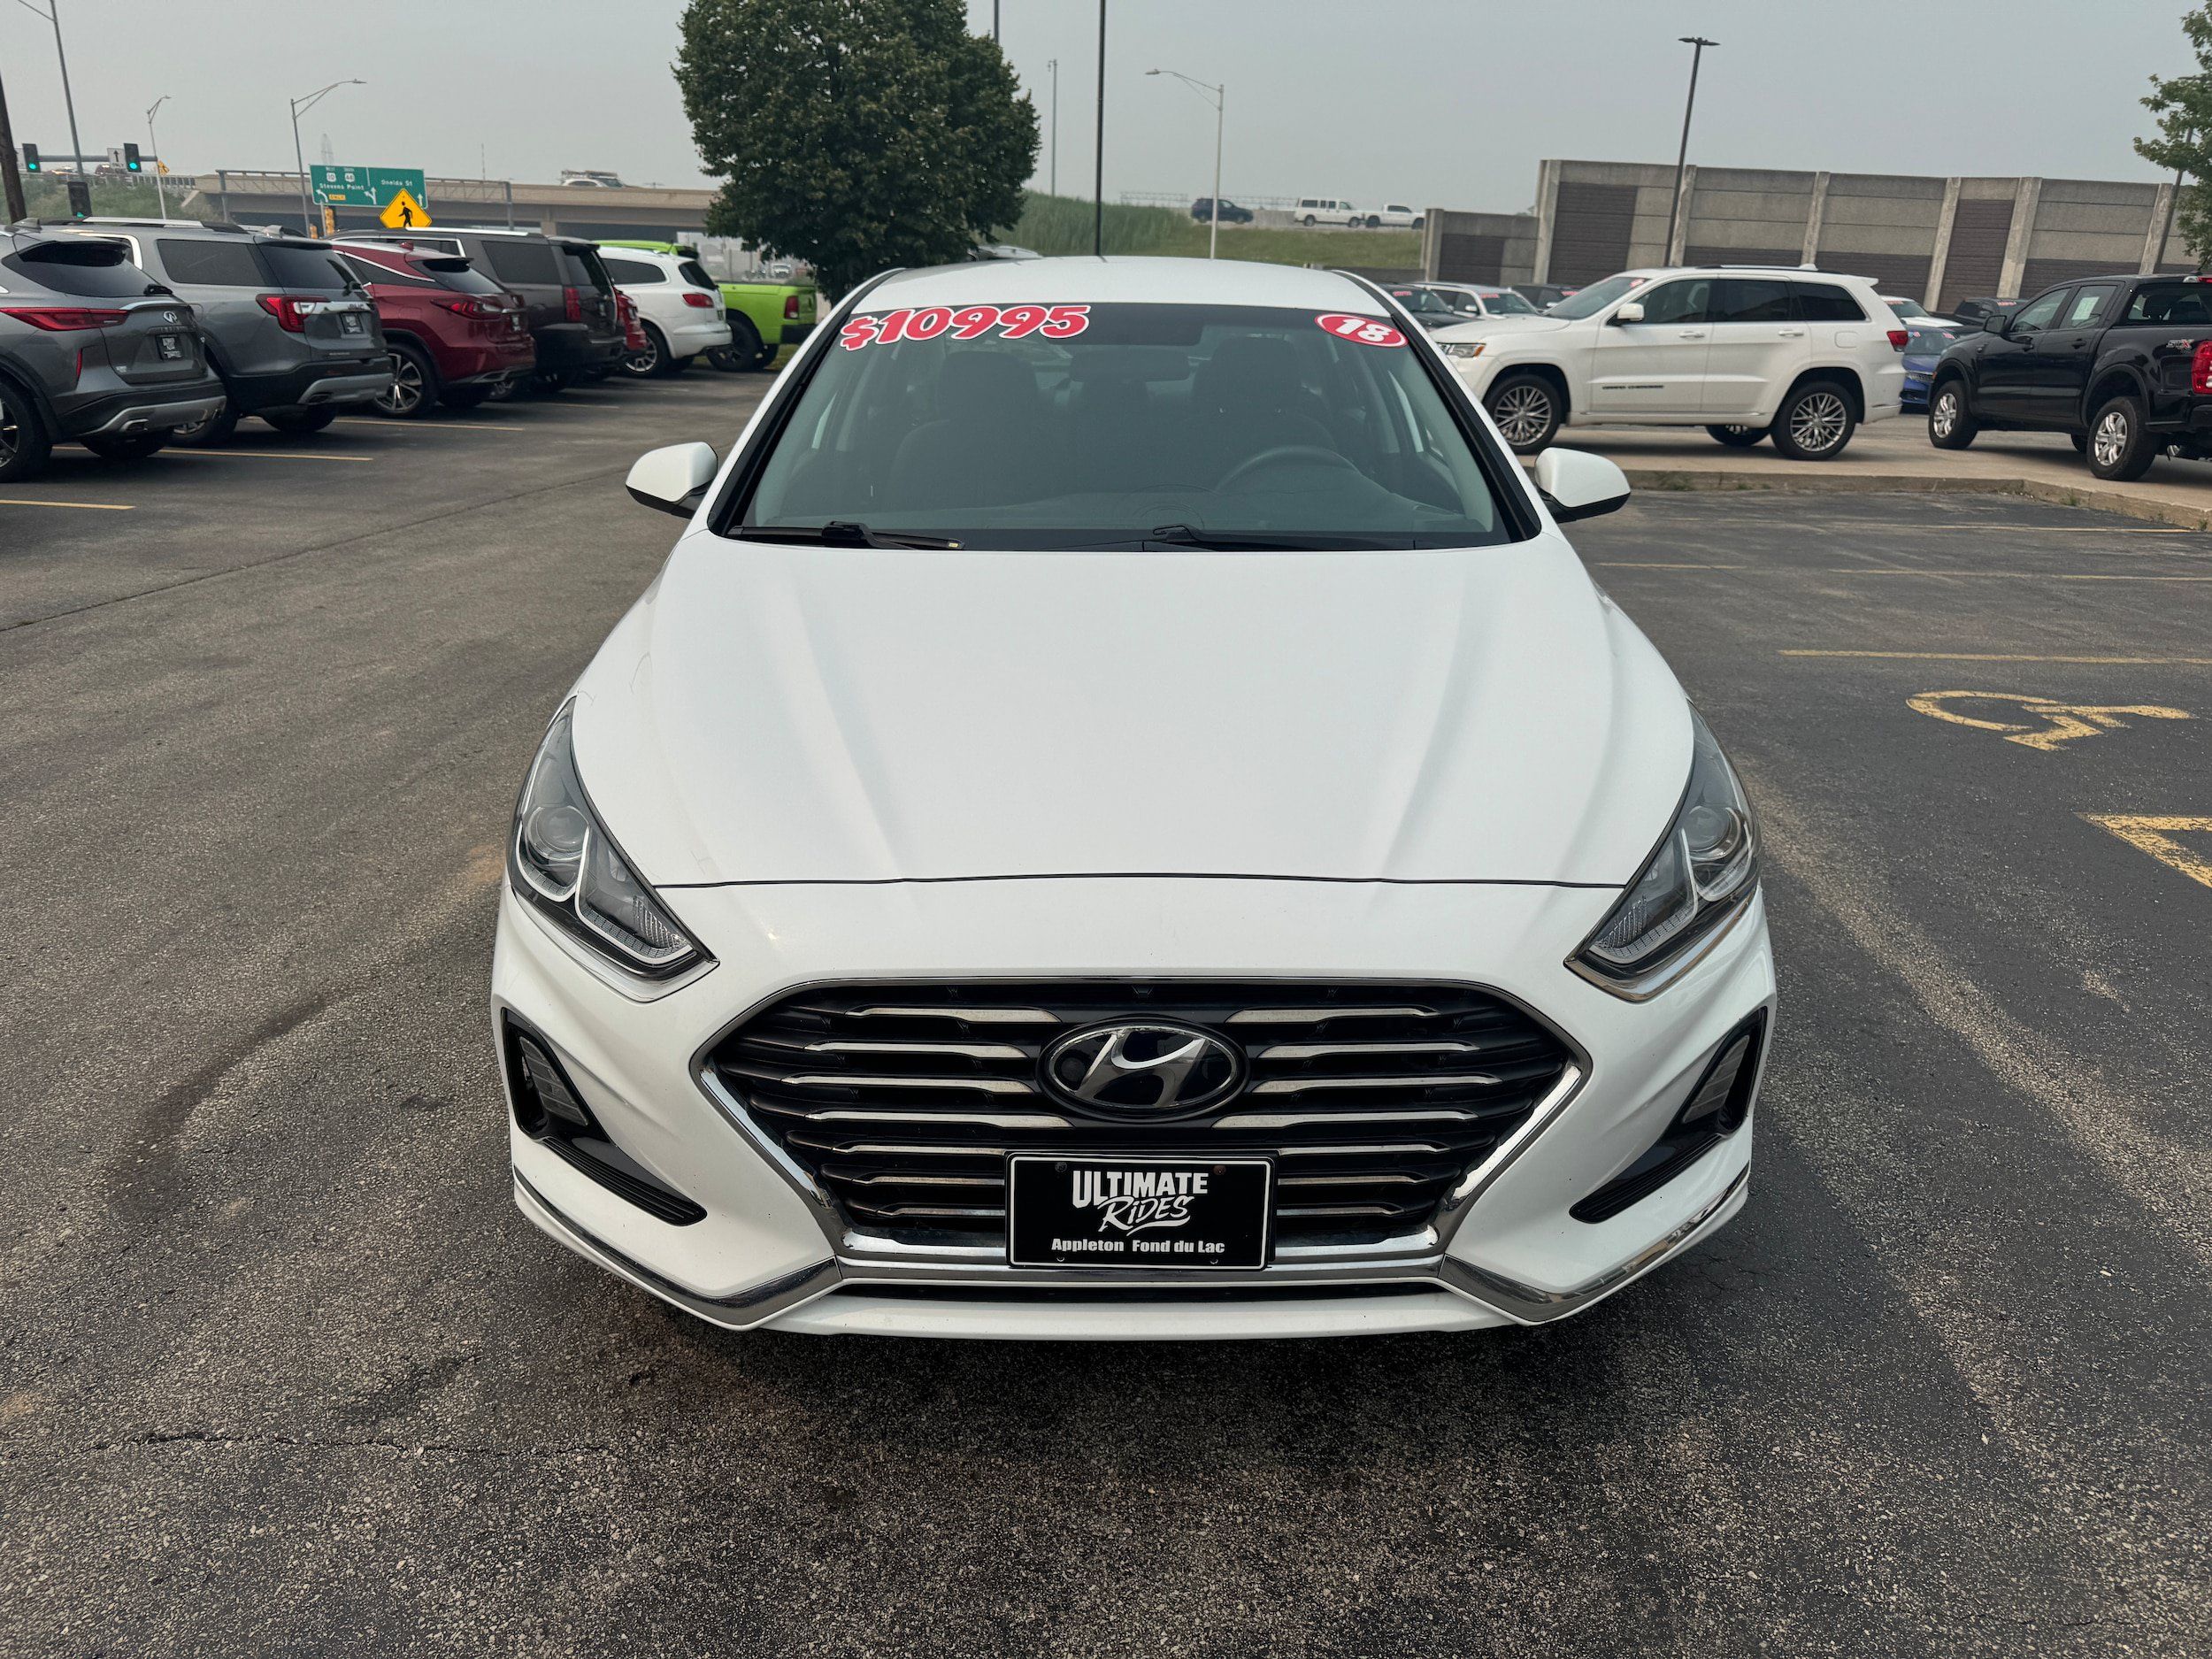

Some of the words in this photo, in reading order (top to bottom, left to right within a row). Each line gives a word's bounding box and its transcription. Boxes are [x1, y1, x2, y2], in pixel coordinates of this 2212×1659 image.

[840, 304, 1091, 350] $10995
[1335, 319, 1393, 342] 18
[1072, 1170, 1210, 1209] ULTIMATE
[1051, 1238, 1125, 1252] Appleton
[1132, 1240, 1171, 1253] Fond
[1174, 1240, 1194, 1253] du
[1197, 1240, 1225, 1254] Lac
